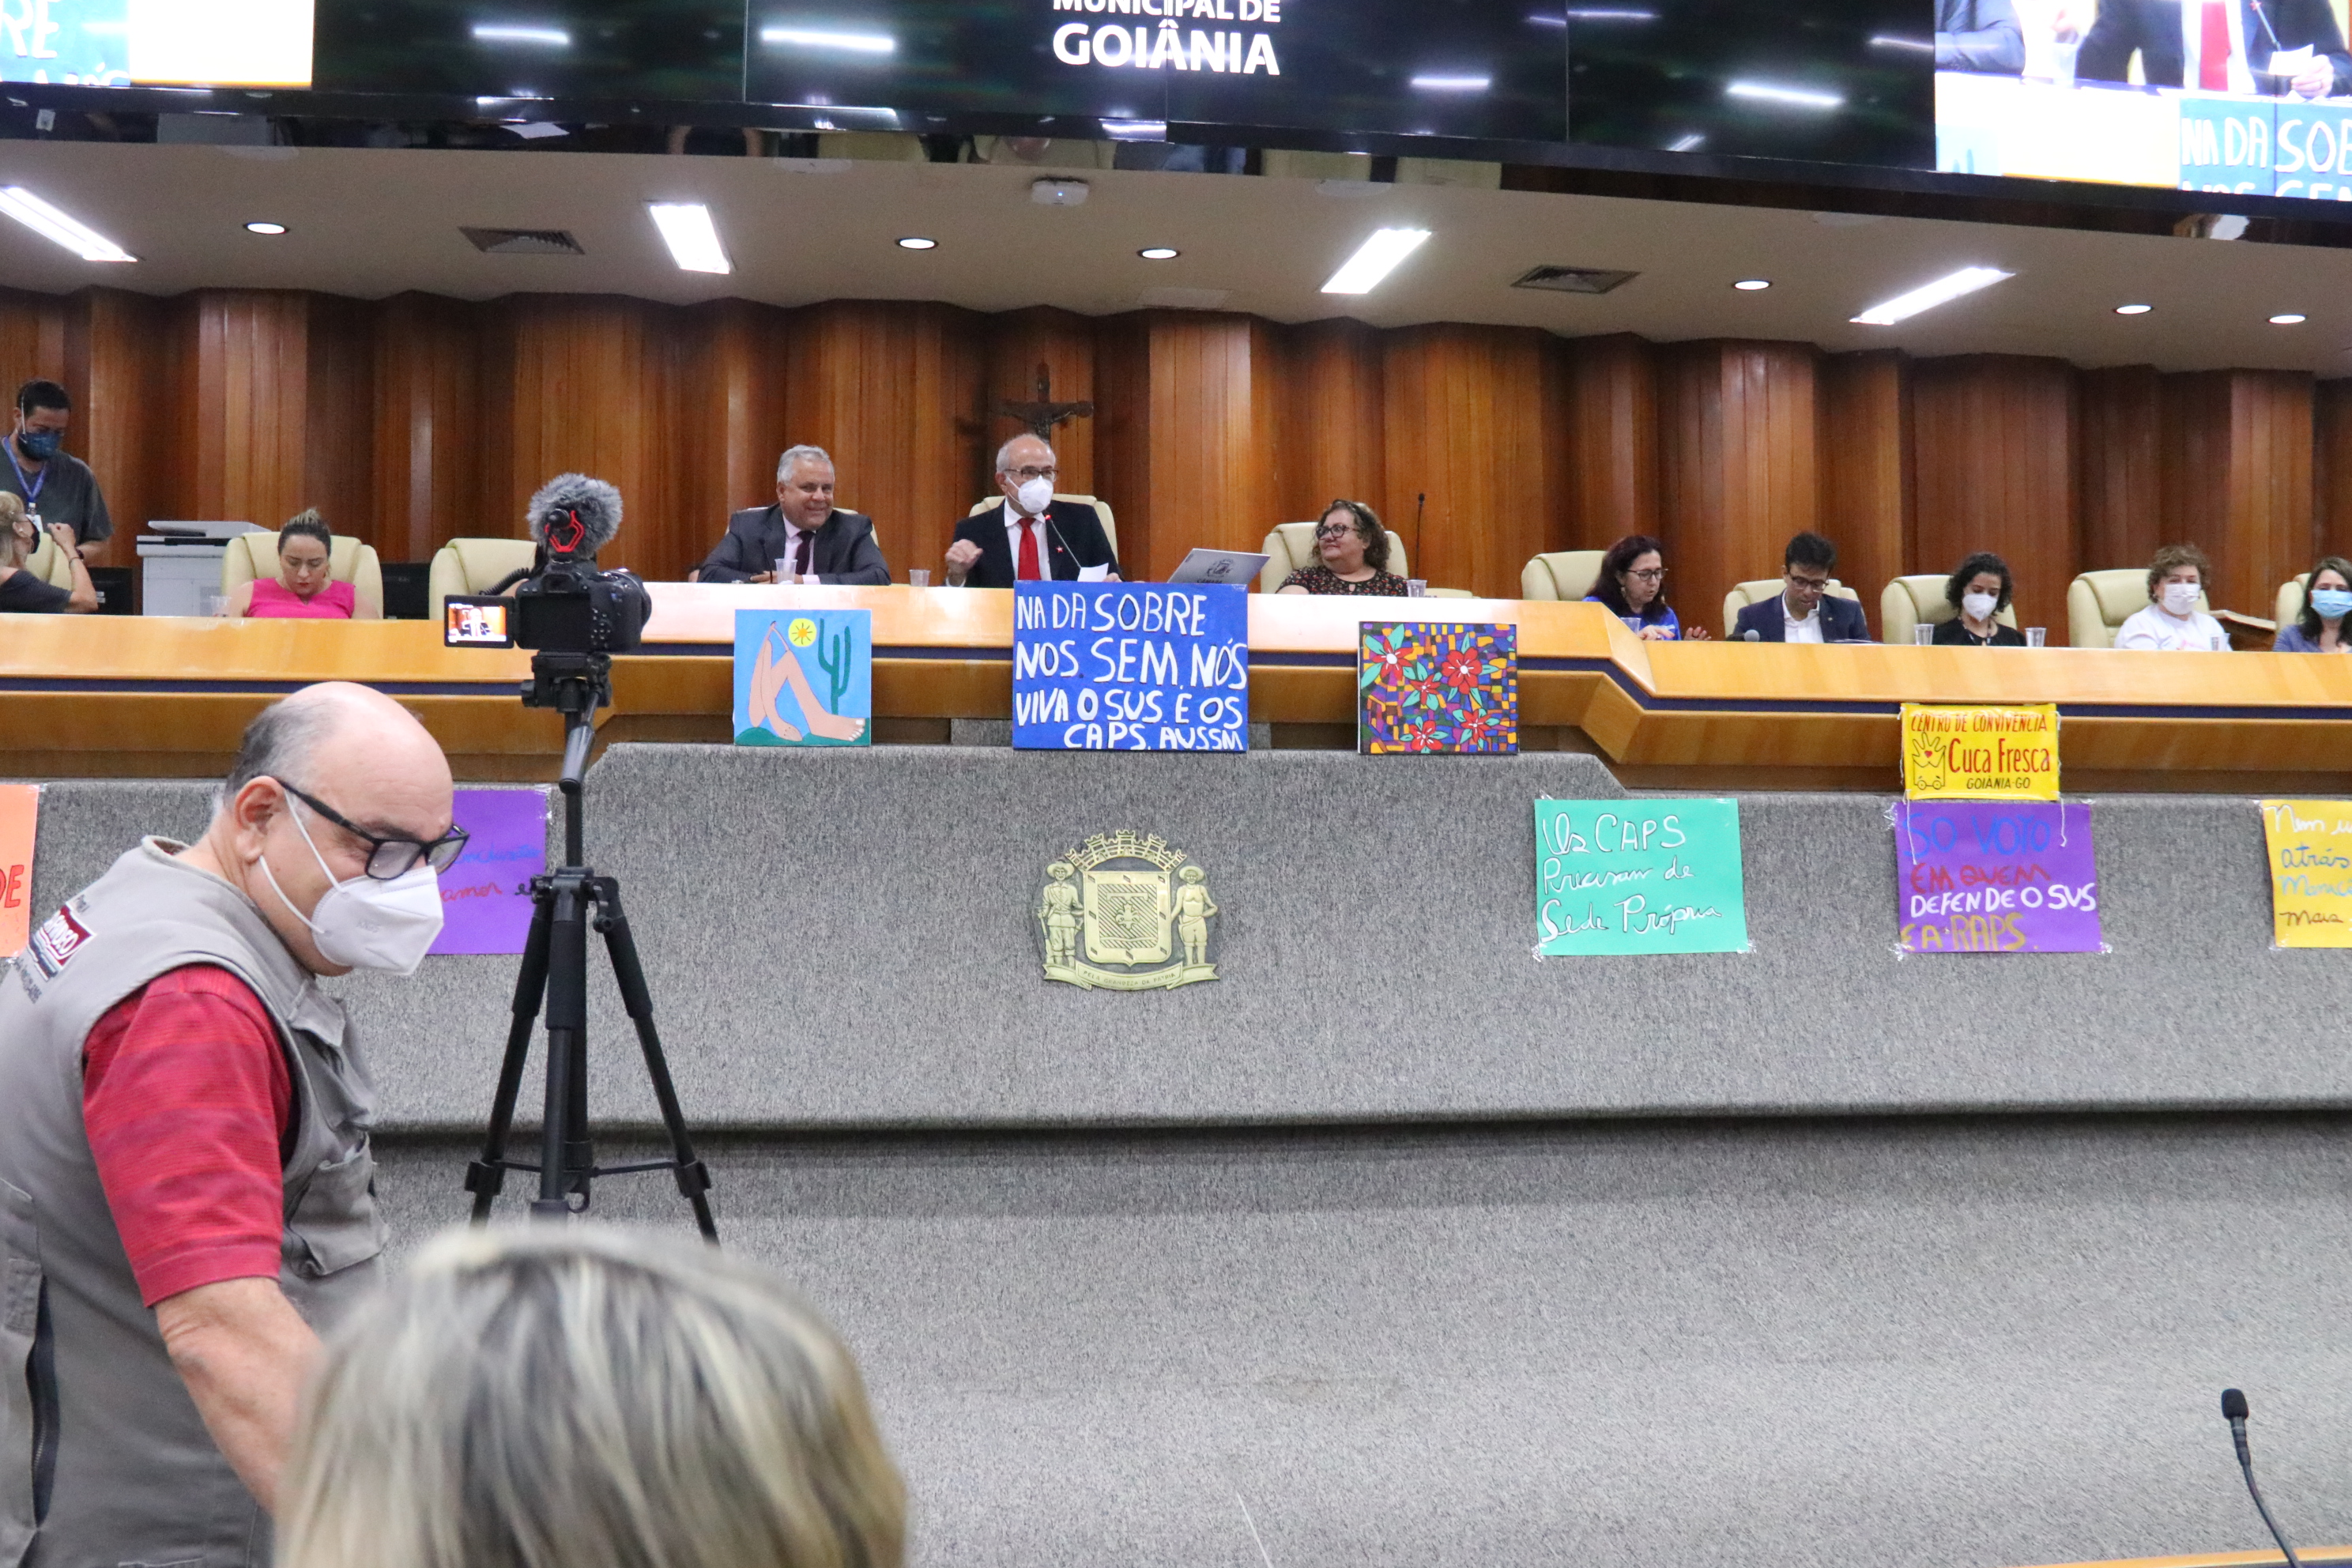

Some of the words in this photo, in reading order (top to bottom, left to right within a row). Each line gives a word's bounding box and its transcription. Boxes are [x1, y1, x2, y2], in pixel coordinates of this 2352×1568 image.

[1239, 0, 1280, 22] DE
[1053, 19, 1280, 75] GOIÂNIA
[1091, 592, 1207, 635] SOBRE
[1190, 638, 1247, 690] NÓS
[1016, 688, 1069, 726] VIVA
[1077, 688, 1098, 721] O
[1104, 689, 1163, 723] SUS
[1200, 697, 1242, 729] OS
[1911, 714, 1952, 732] CENTRO
[1955, 714, 1967, 732] DE
[1159, 726, 1243, 751] AUSSM
[1948, 737, 1991, 773] Cuca
[1998, 737, 2051, 773] Fresca
[1595, 813, 1686, 852] CAPS
[1972, 814, 2051, 856] VOTO
[1544, 857, 1653, 895] Precisam
[1664, 854, 1695, 880] de
[1541, 899, 1609, 943] Sede
[1911, 888, 2015, 918] DEFENDE
[2048, 883, 2096, 911] SUS
